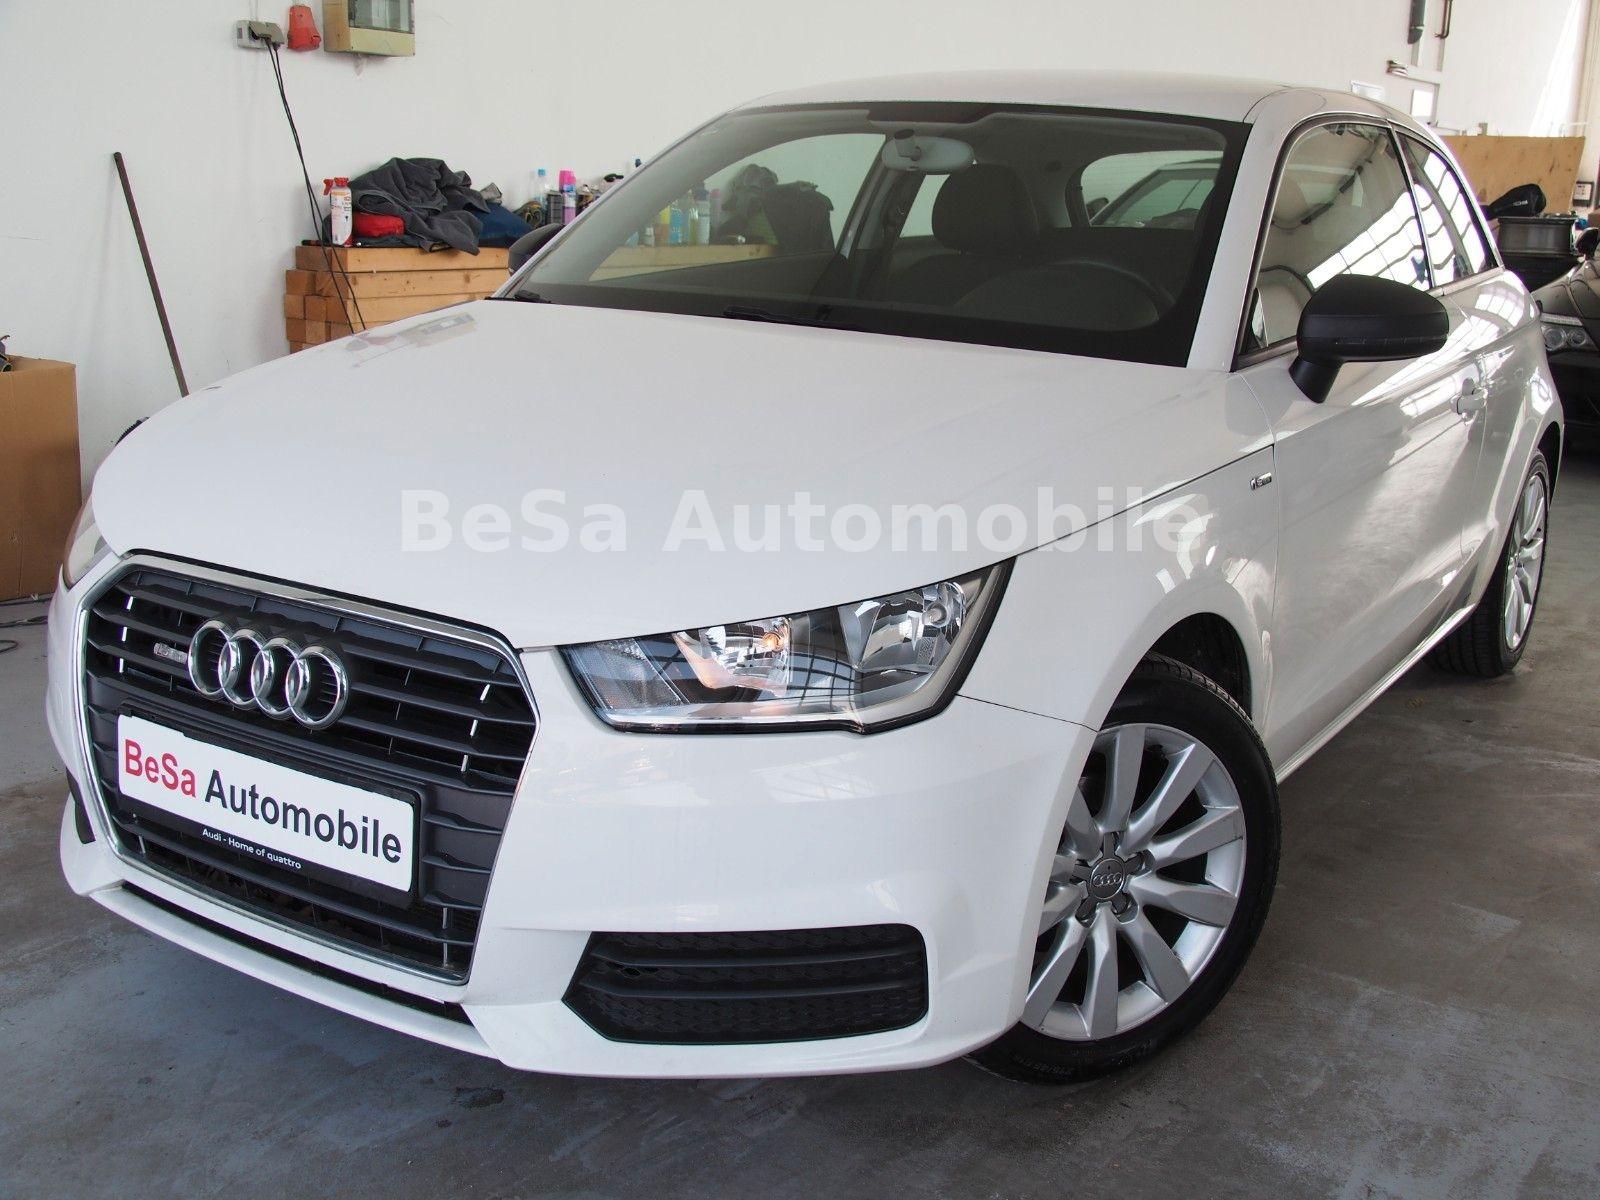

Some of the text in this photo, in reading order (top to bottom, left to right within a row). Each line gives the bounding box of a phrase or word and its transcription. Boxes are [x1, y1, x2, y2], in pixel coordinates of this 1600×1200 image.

[124, 738, 402, 863] BeSa Automobile
[202, 828, 222, 842] Audi
[228, 836, 254, 853] Home
[255, 848, 266, 857] of
[266, 852, 302, 869] quattro
